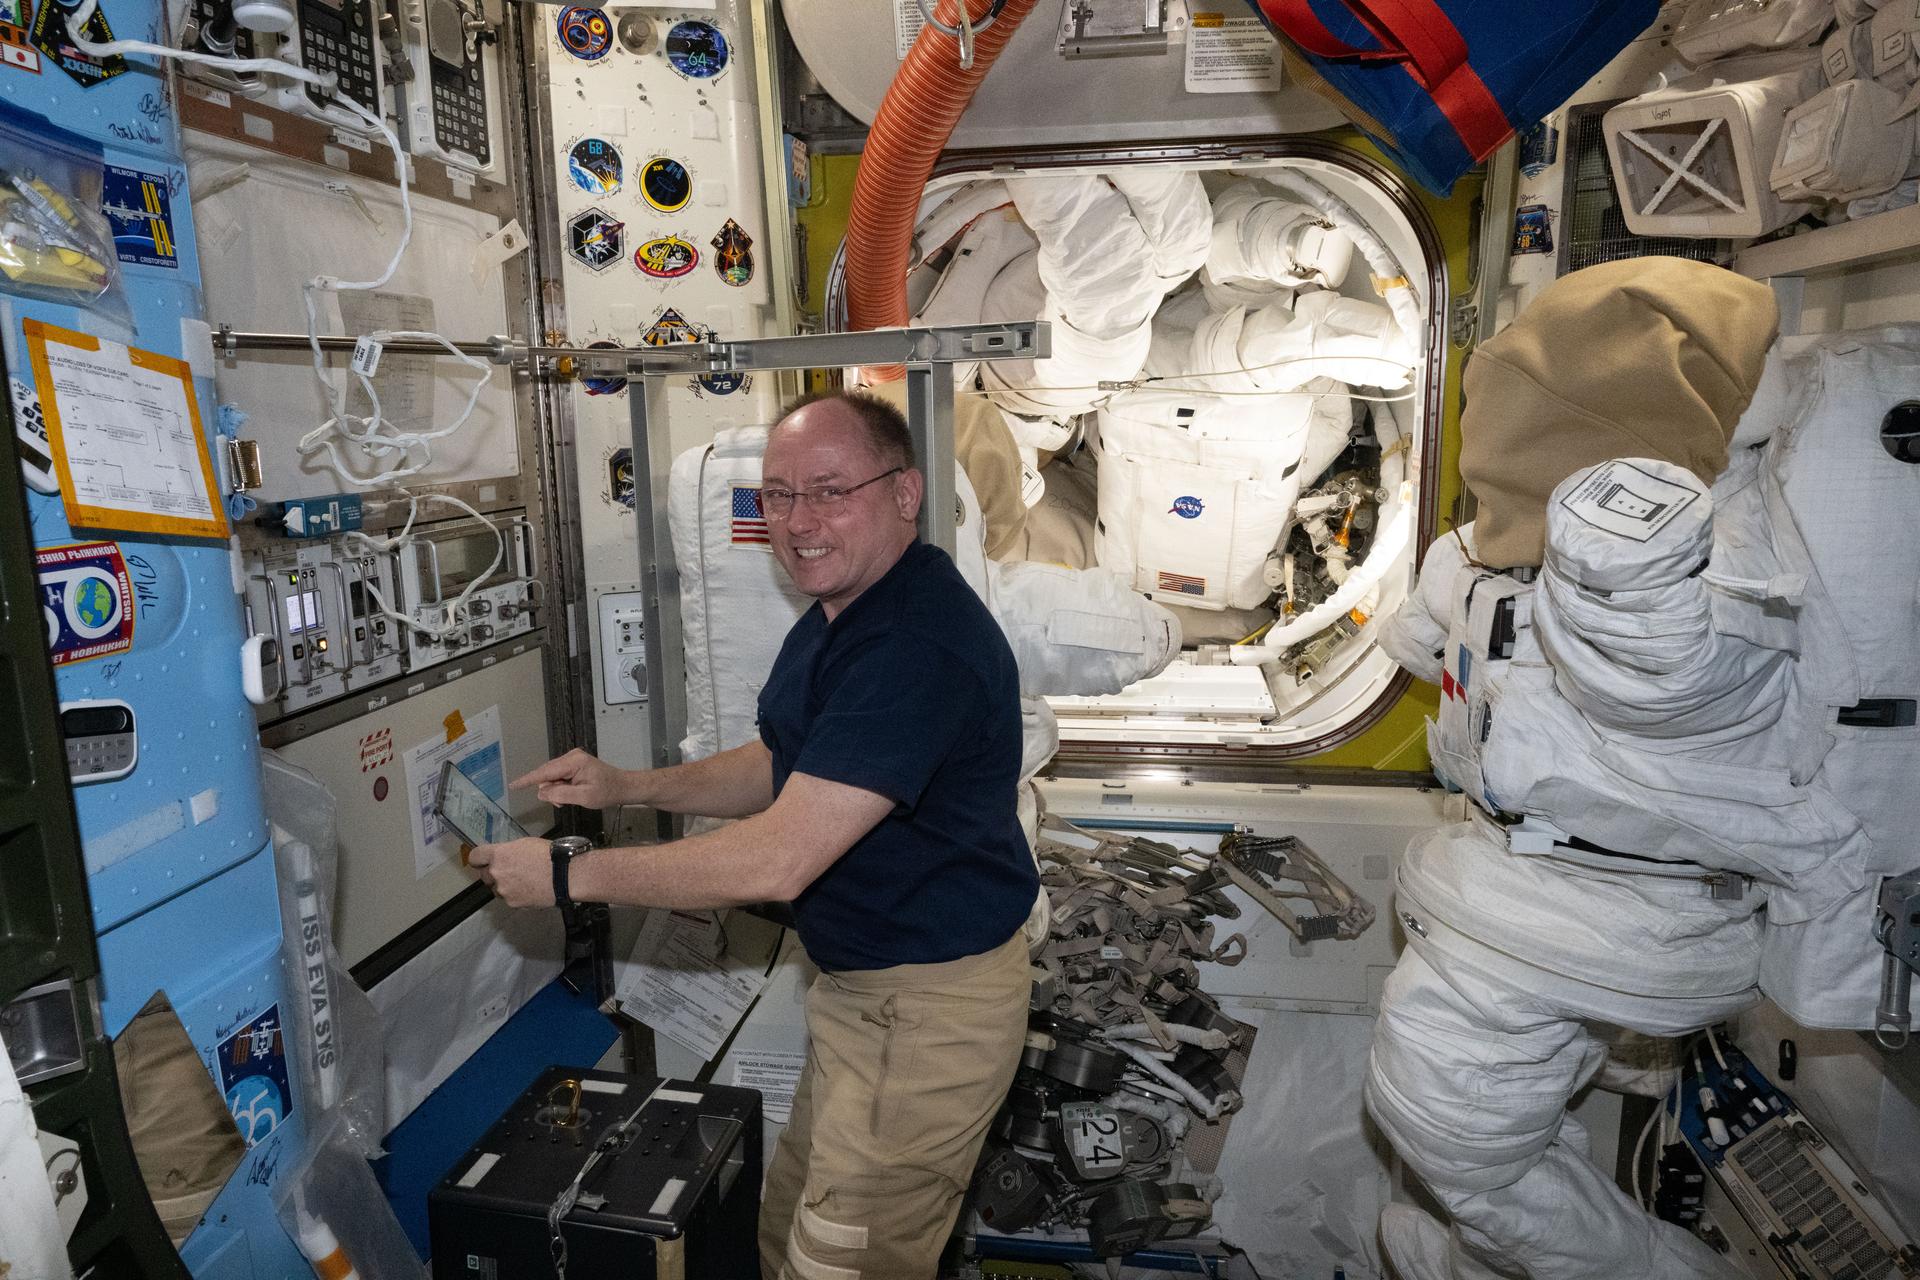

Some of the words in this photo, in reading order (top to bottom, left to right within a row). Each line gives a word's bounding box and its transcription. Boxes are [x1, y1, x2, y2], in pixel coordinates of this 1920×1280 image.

[688, 51, 708, 67] 64
[589, 141, 603, 155] 68
[111, 167, 138, 179] WILMORE
[119, 253, 136, 262] VIRTS
[713, 381, 732, 390] 72
[1175, 501, 1201, 513] NASA
[68, 544, 118, 560] РЫЖИКОВ
[117, 571, 132, 622] WHITSON
[70, 638, 131, 661] НОВИЦКИЙ
[302, 914, 322, 956] ISS
[308, 966, 328, 1020] EVA
[316, 1022, 335, 1070] SYS
